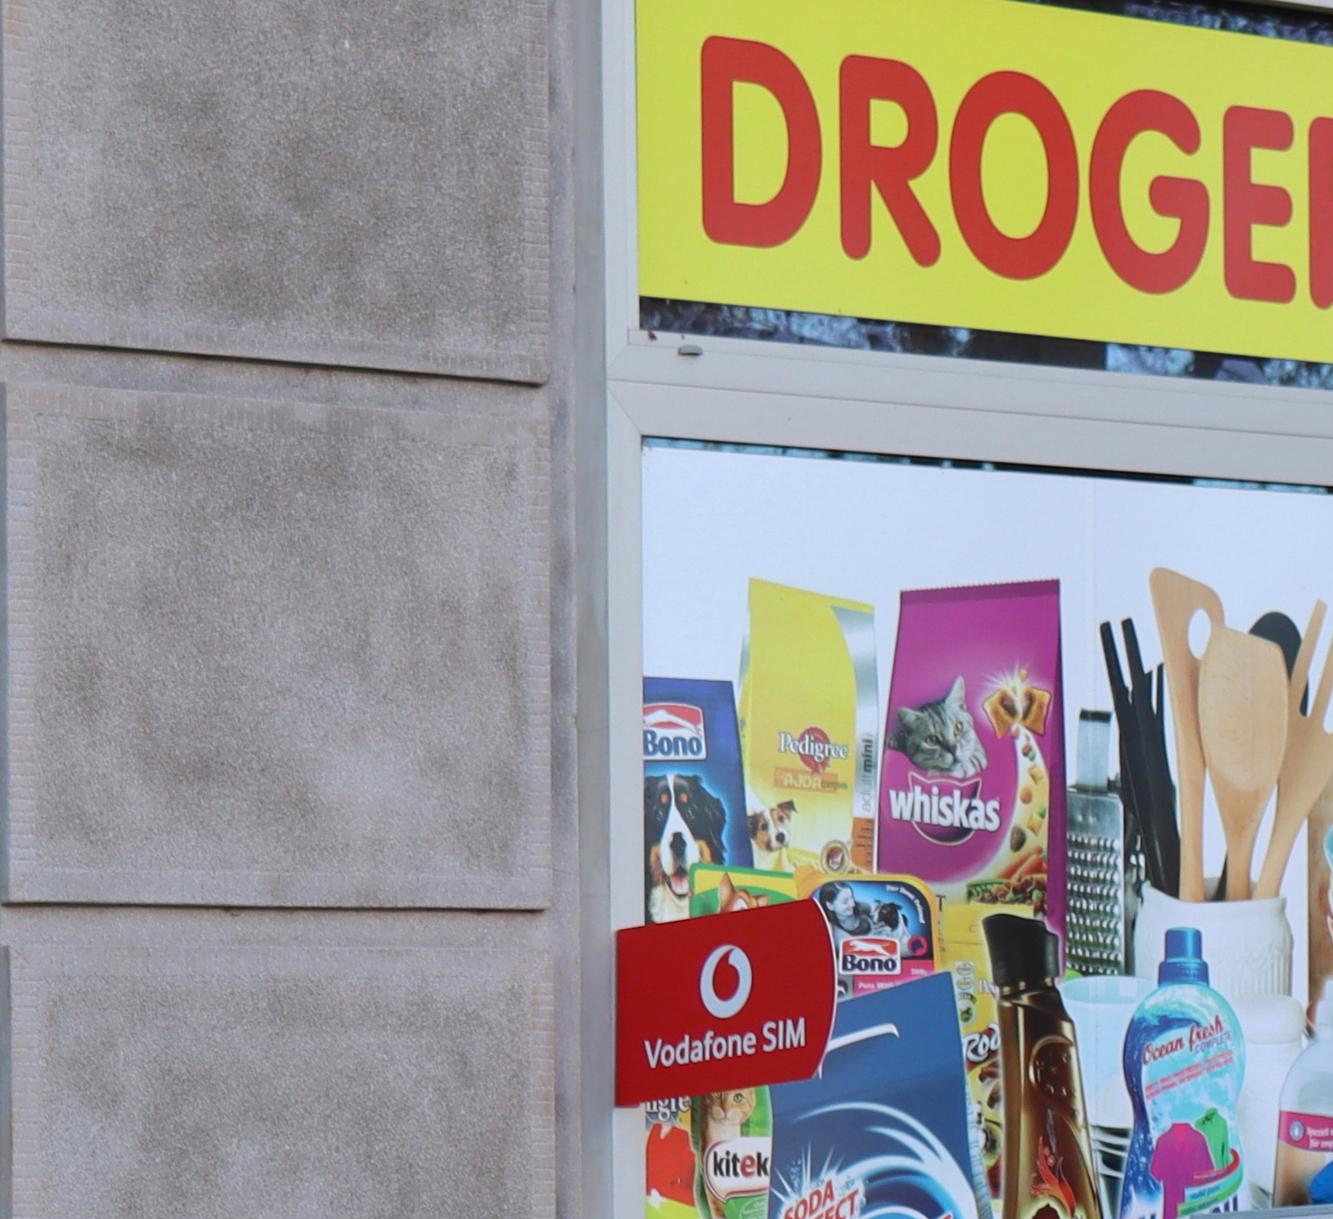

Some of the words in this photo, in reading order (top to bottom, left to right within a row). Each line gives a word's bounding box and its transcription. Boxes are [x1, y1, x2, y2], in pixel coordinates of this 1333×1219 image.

[643, 729, 703, 757] Bono
[778, 731, 848, 762] Pedigree
[889, 786, 1001, 834] whiskas
[841, 955, 897, 972] Bono
[644, 1028, 757, 1069] Vodafone
[761, 1016, 806, 1052] SIM
[1142, 1035, 1185, 1066] Ocean
[1188, 1014, 1224, 1053] fresh
